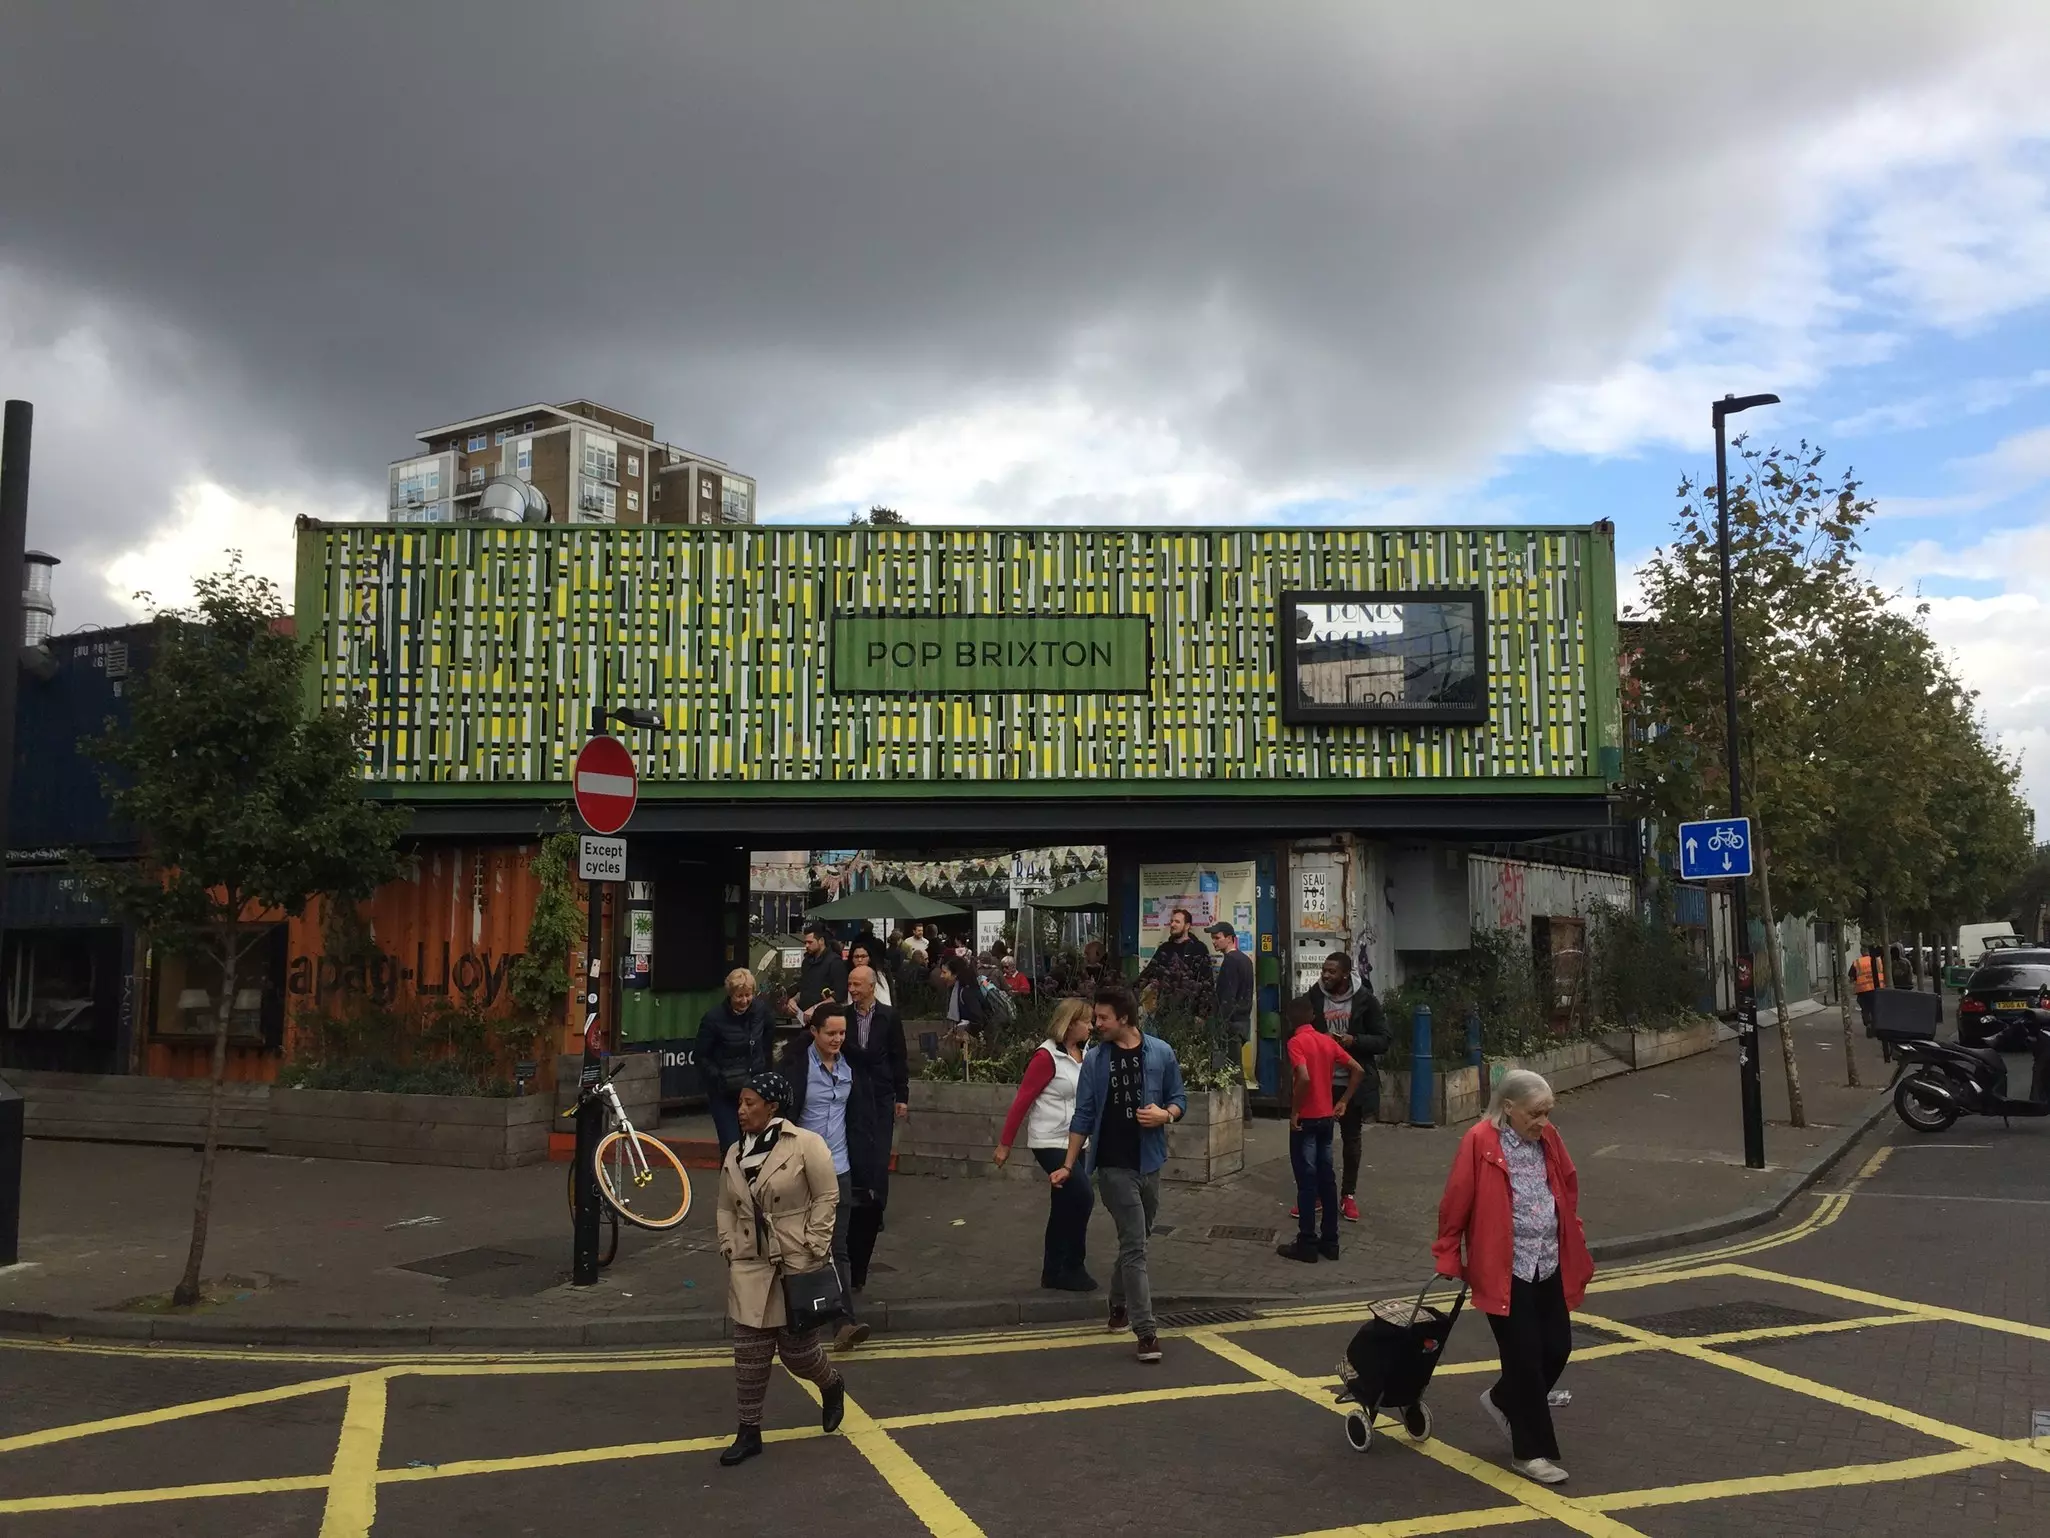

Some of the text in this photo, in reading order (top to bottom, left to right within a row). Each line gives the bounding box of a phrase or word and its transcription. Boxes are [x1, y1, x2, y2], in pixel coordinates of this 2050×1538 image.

[867, 641, 1112, 667] POP BRIXTON
[585, 842, 623, 859] Except
[586, 861, 621, 875] cycles
[1303, 874, 1325, 886] SEAU
[1304, 899, 1325, 911] 496
[288, 941, 525, 1007] apag-Lloy
